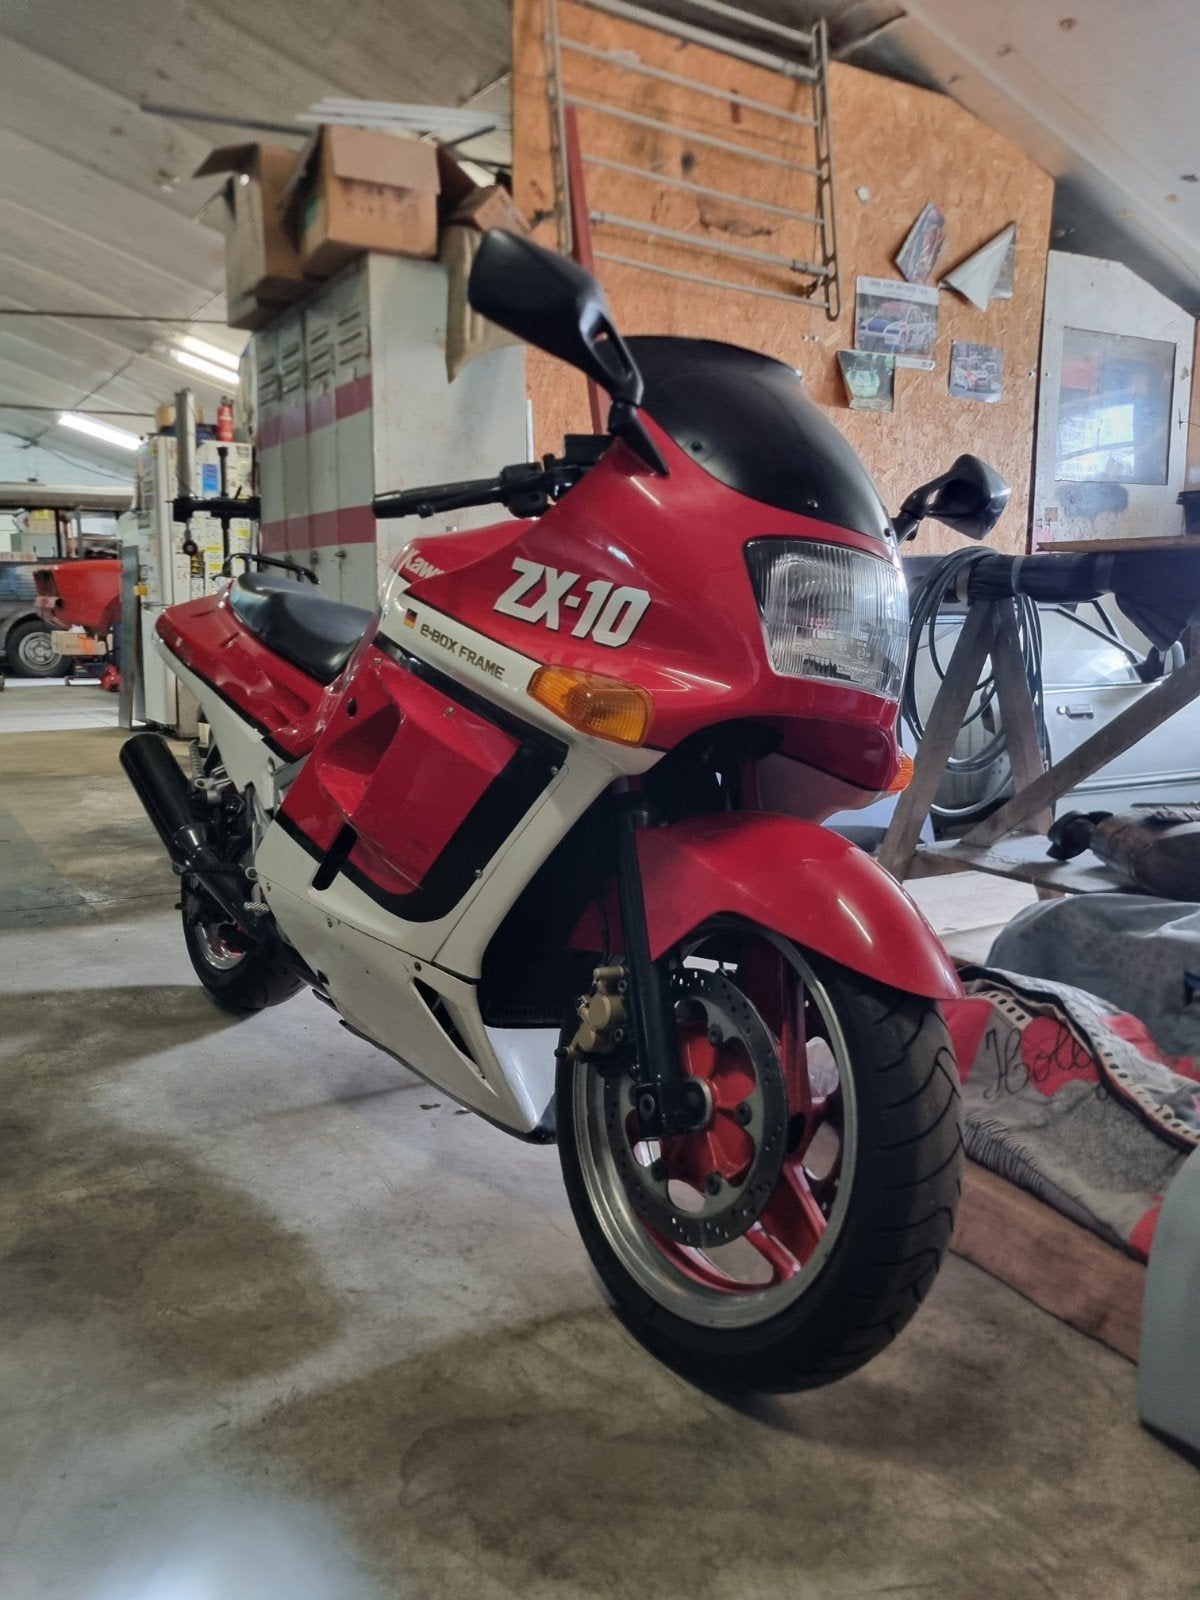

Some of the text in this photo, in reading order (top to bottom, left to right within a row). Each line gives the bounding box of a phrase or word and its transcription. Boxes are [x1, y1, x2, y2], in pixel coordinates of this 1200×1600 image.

[403, 548, 446, 579] Kaw
[493, 557, 651, 648] ZX-10
[459, 645, 505, 680] FRAME
